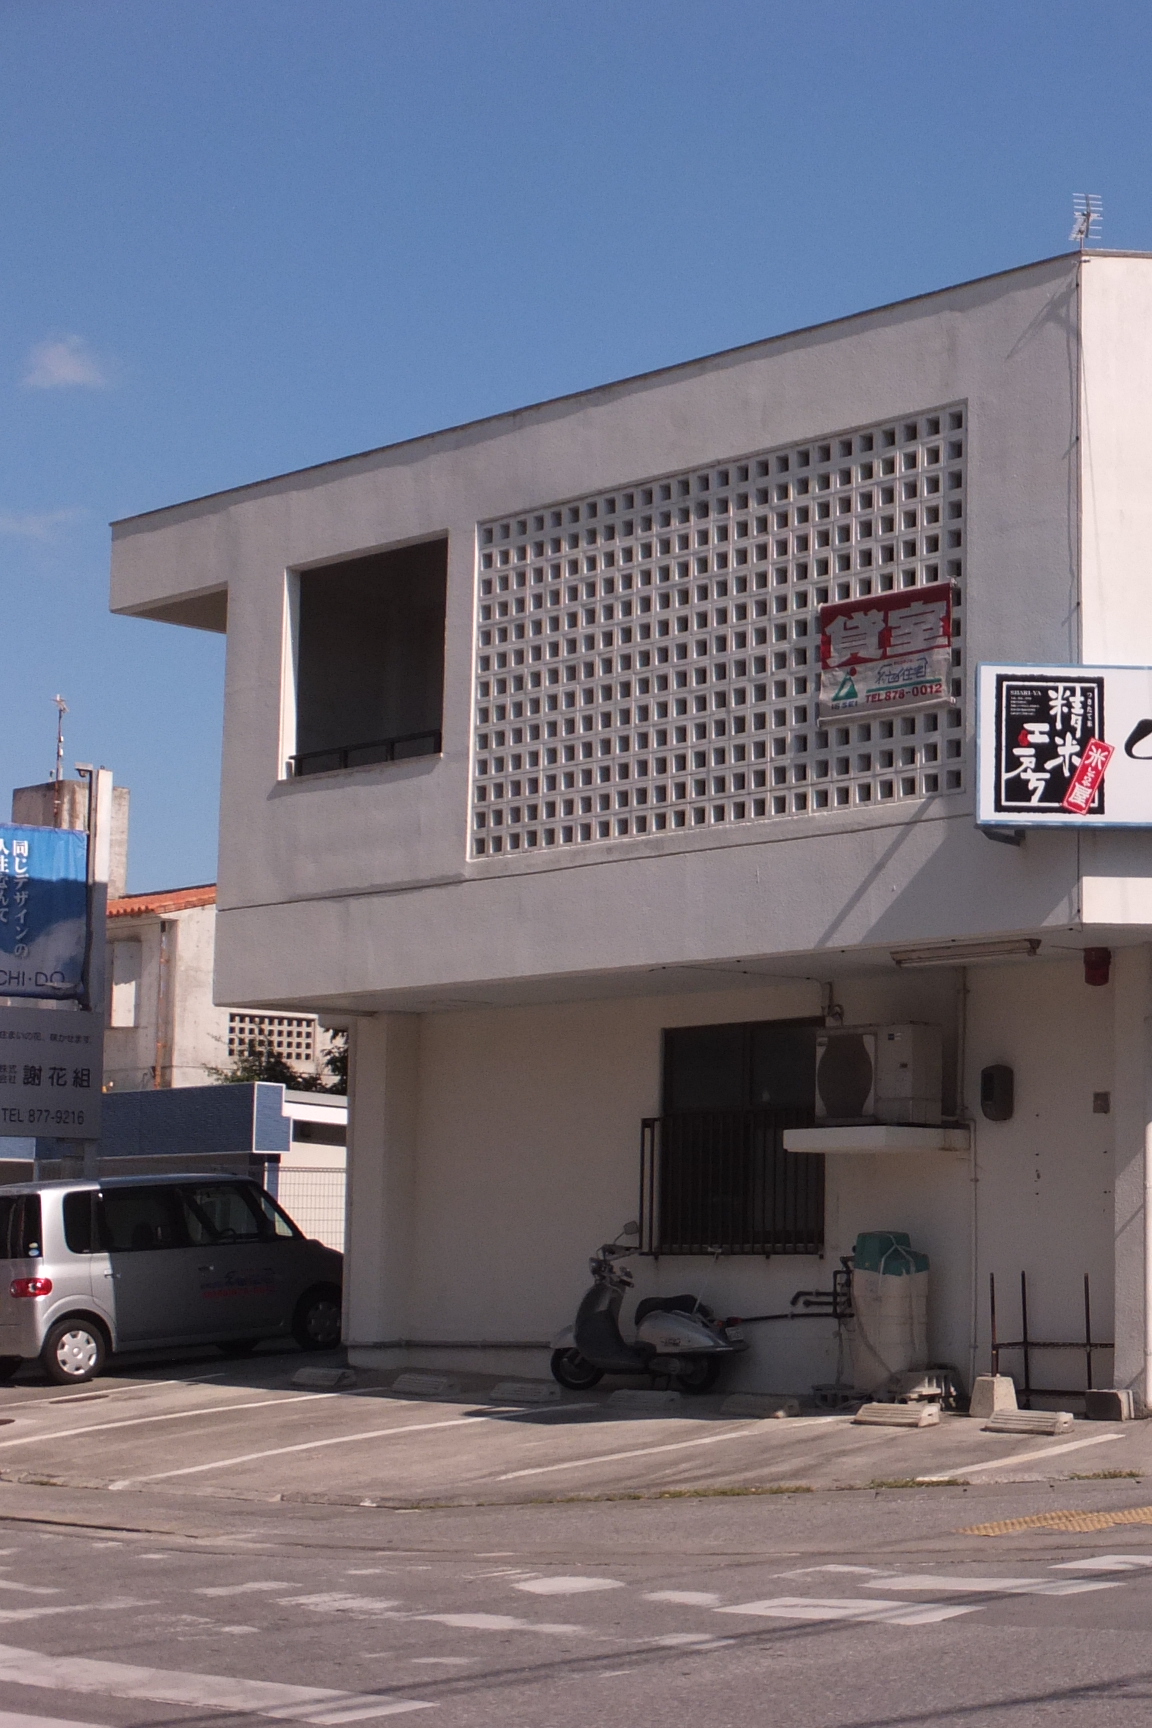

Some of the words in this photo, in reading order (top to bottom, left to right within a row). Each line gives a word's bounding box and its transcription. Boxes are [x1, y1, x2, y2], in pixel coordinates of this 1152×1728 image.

[825, 601, 948, 667] 貸室
[866, 691, 884, 703] TEL
[12, 840, 30, 958] 同じデザインの
[23, 1065, 91, 1088] 謝花組
[1, 1108, 24, 1123] TEL
[28, 1109, 85, 1125] 877-9216
